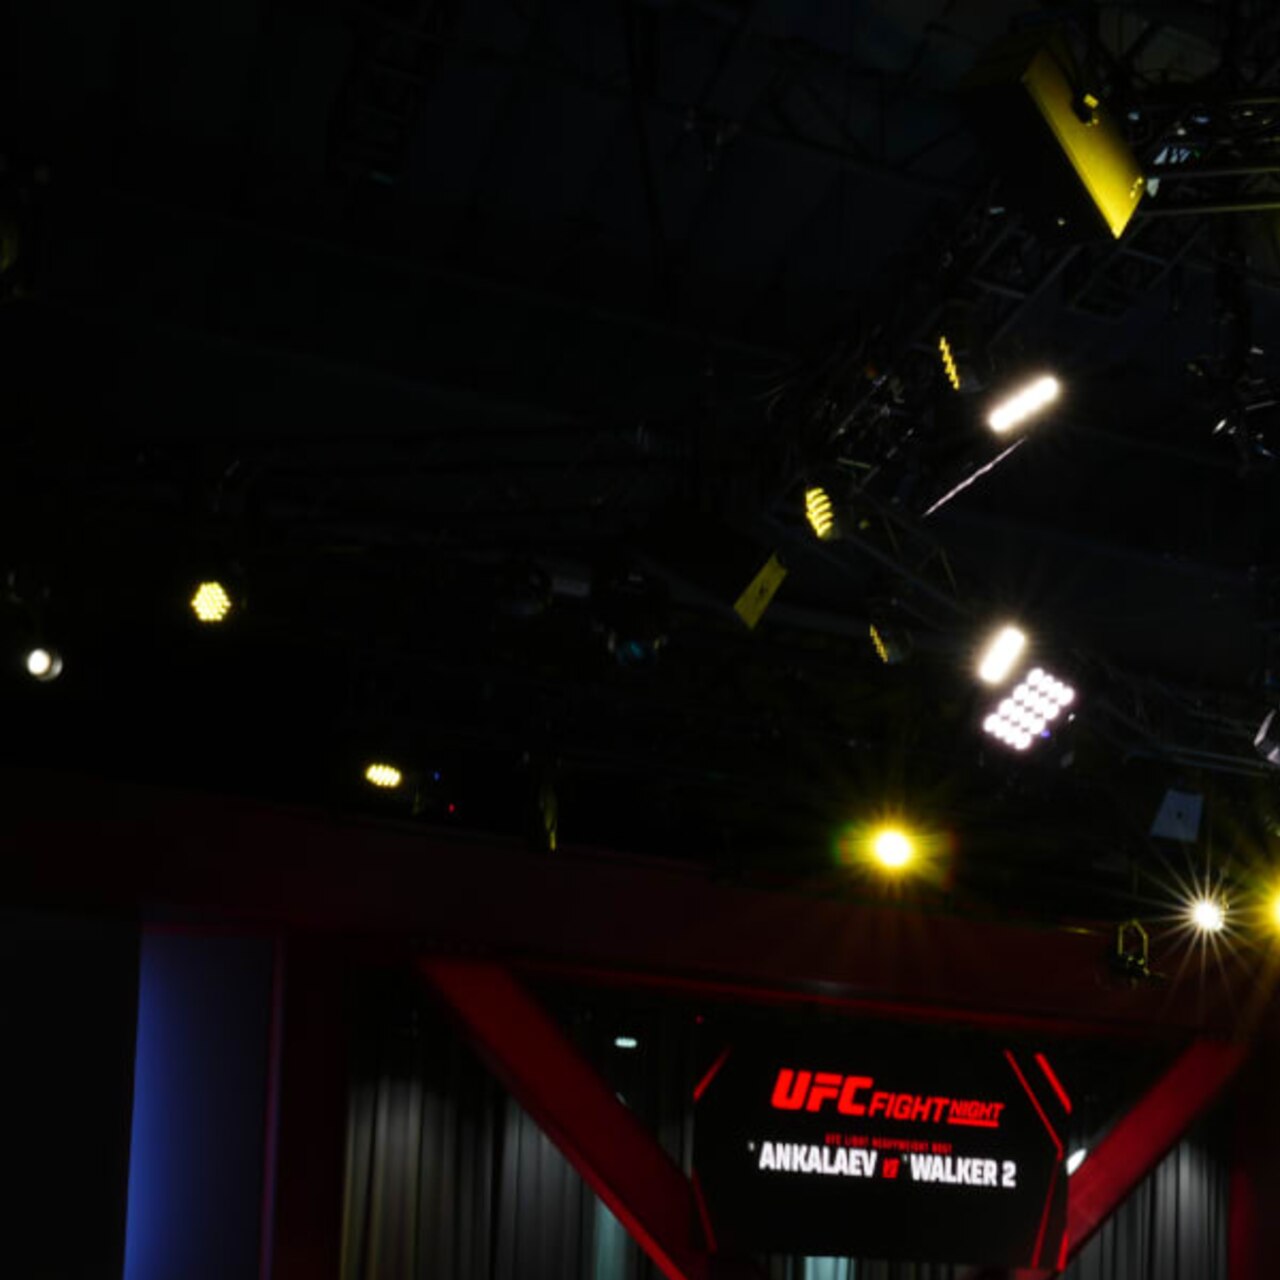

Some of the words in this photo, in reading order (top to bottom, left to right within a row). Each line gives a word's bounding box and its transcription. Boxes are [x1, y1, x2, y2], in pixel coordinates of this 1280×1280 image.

[770, 1067, 875, 1117] UFC
[868, 1091, 950, 1124] FIGHT
[948, 1100, 1006, 1122] NIGHT
[758, 1140, 878, 1178] ANKALAEV
[909, 1153, 998, 1187] WALKER
[1001, 1160, 1017, 1188] 2
